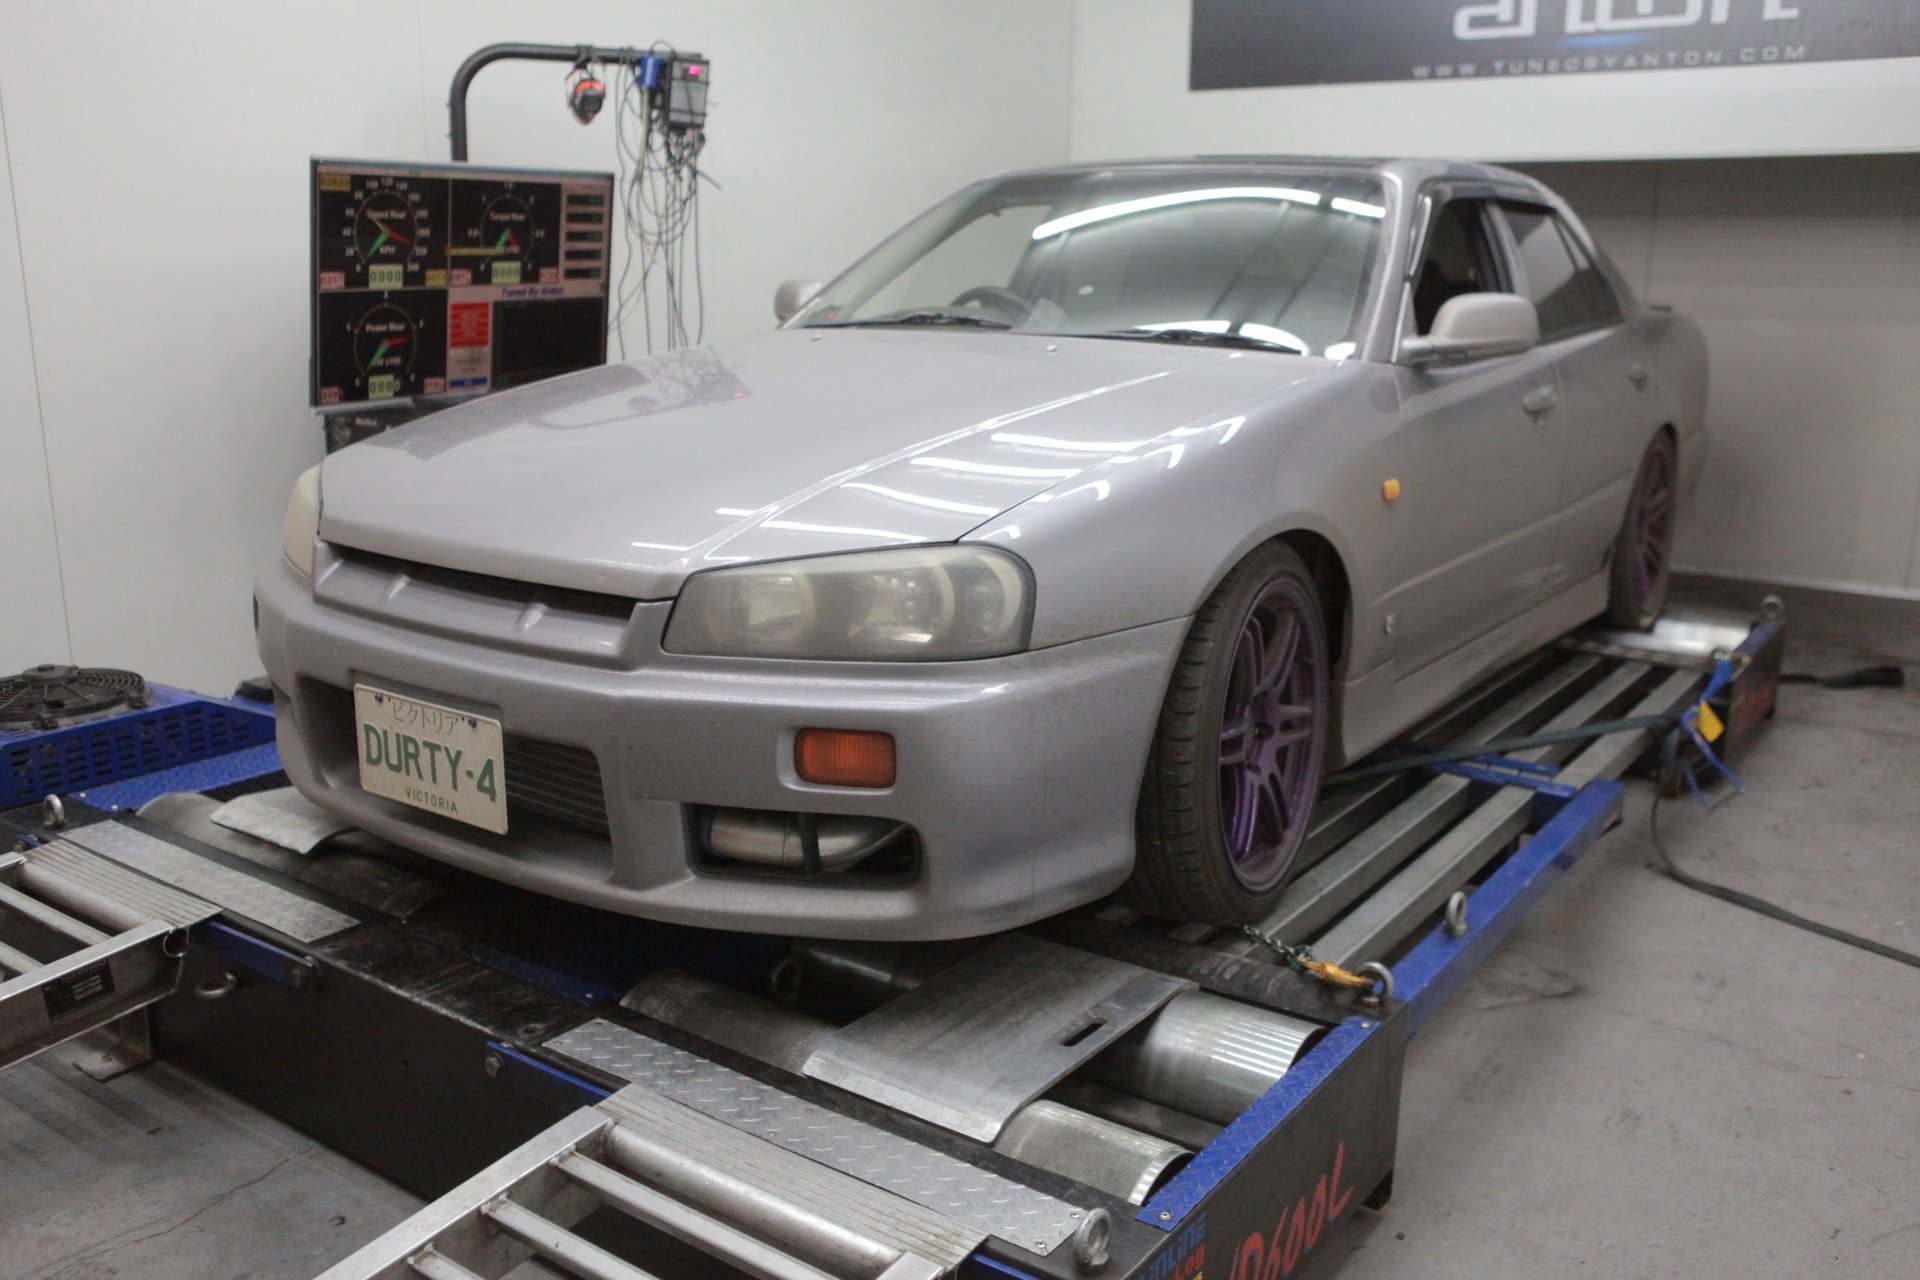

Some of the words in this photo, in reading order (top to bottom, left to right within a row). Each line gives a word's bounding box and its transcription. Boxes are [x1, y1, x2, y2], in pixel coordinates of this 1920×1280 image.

[369, 271, 401, 281] 0000
[363, 723, 497, 803] DURTY-4
[405, 786, 458, 814] VICTORIA
